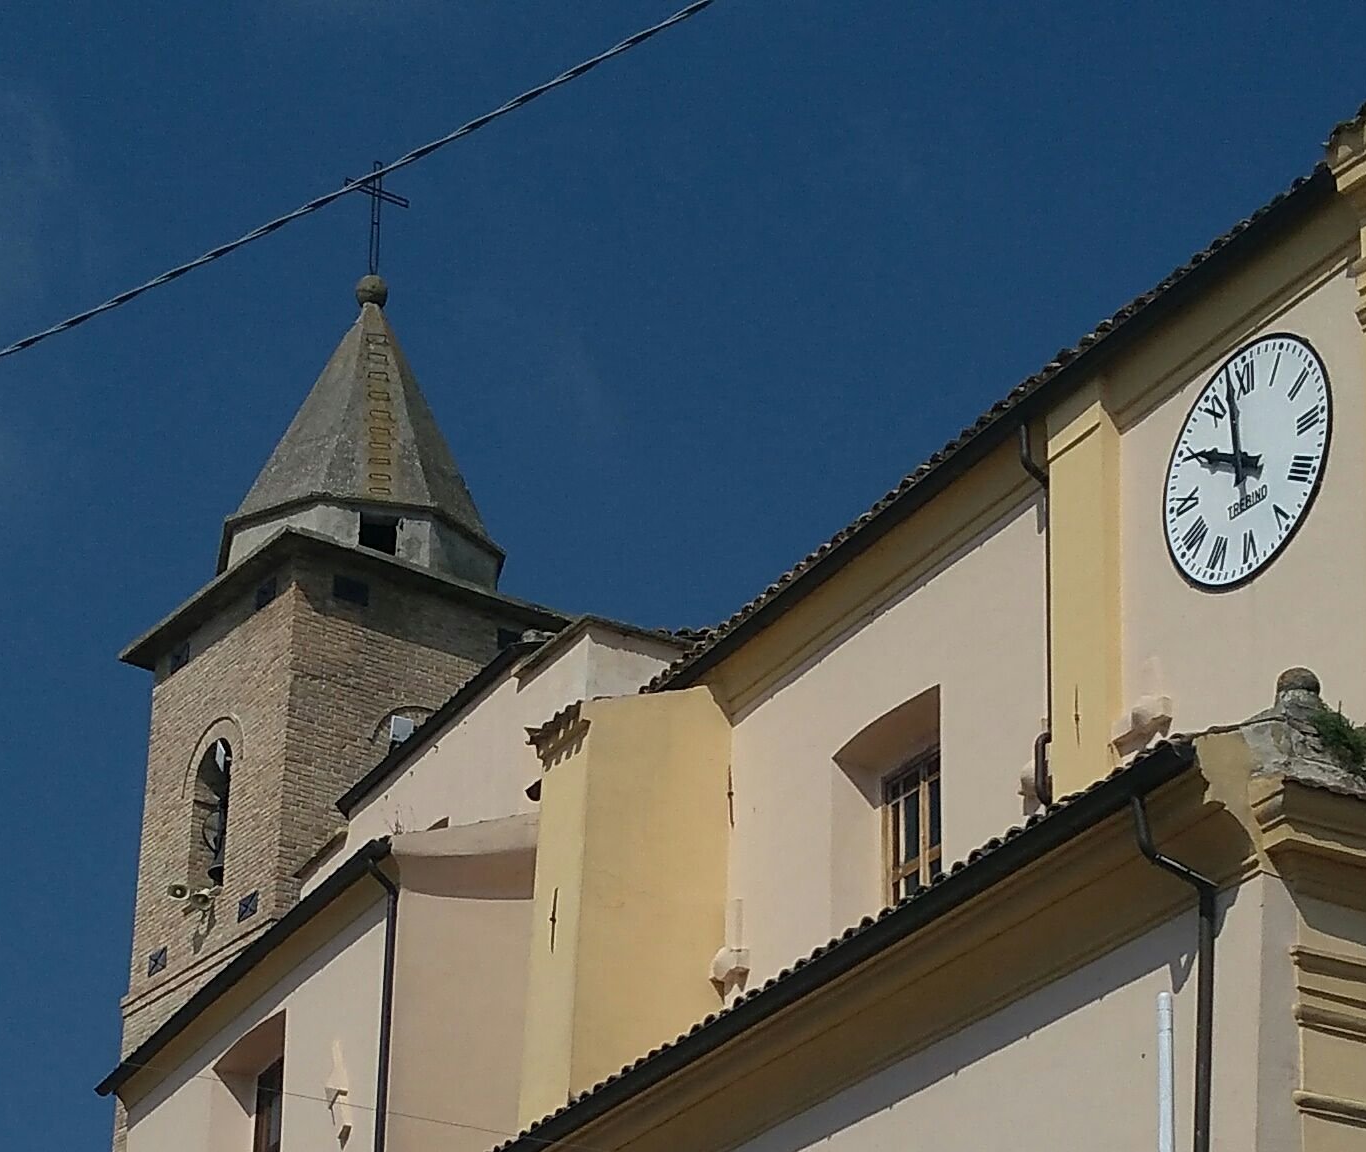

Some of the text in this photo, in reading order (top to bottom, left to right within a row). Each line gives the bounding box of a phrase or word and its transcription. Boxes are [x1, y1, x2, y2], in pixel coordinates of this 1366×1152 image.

[1236, 359, 1255, 400] XII
[1203, 394, 1227, 428] XI
[1296, 404, 1320, 436] III
[1287, 455, 1314, 482] IIII
[1176, 486, 1199, 517] IX
[1227, 484, 1268, 520] TREBINO
[1273, 504, 1290, 531] V
